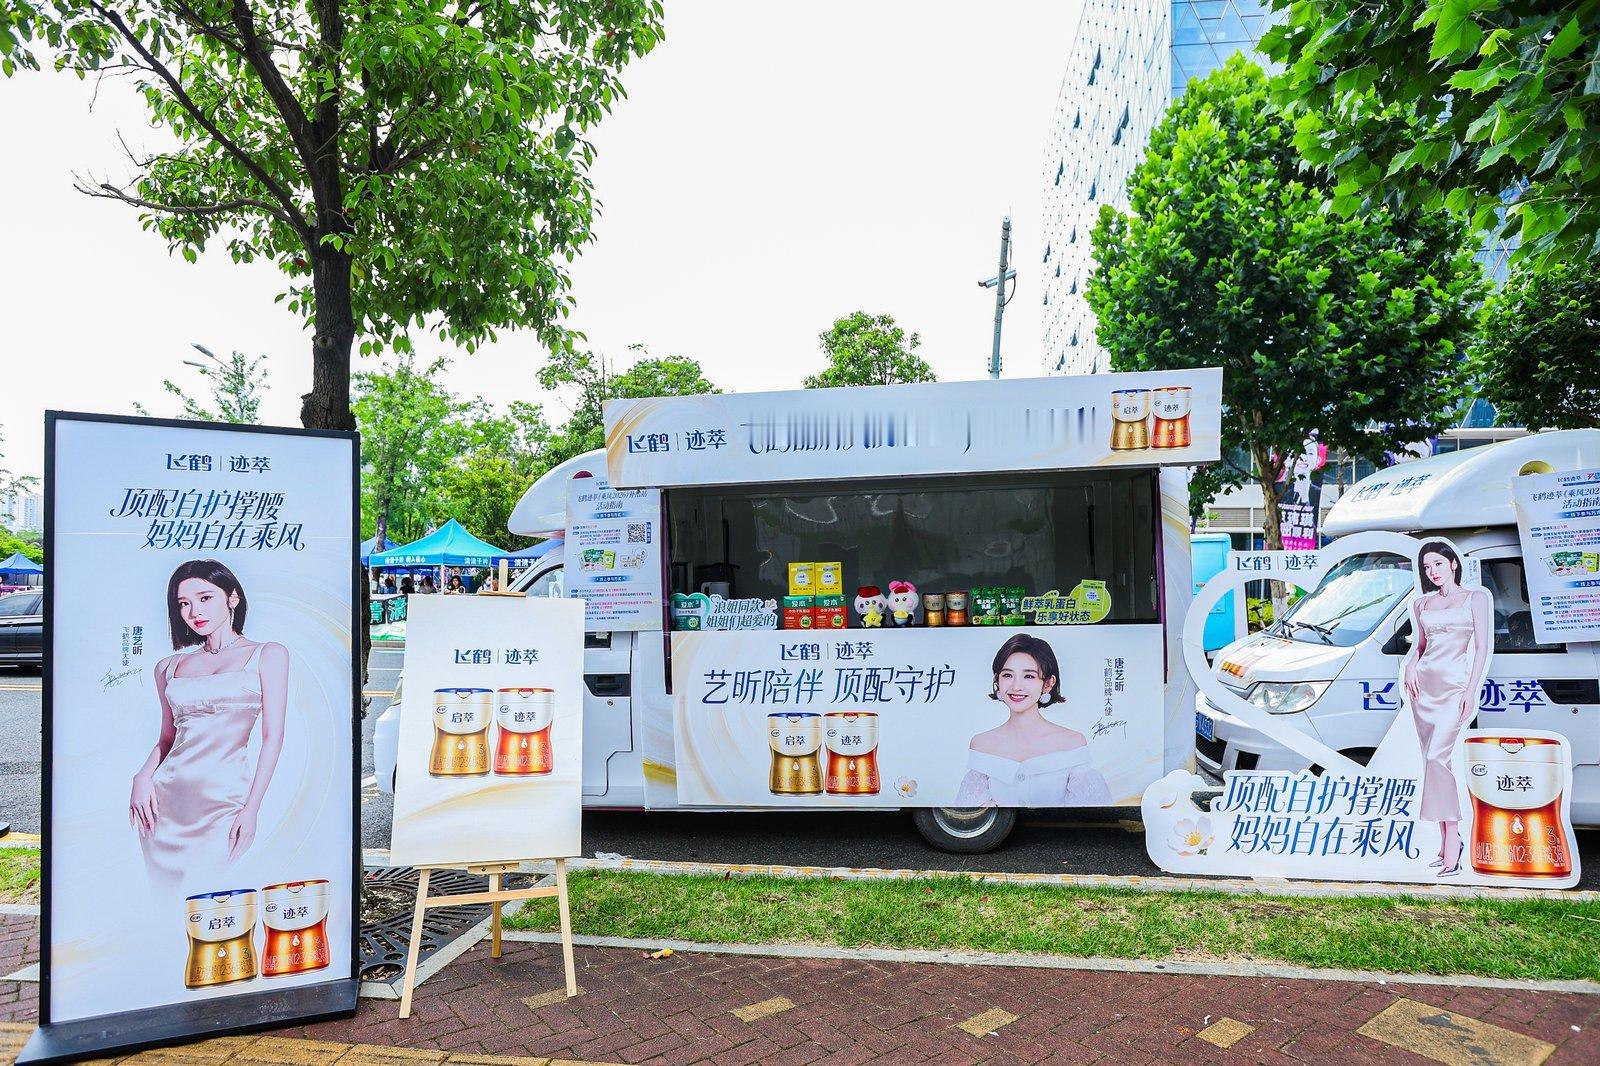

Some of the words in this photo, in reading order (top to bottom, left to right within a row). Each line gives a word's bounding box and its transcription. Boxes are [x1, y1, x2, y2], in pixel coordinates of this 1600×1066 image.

[626, 432, 669, 454] 飞鹤
[685, 429, 727, 451] 迹萃
[165, 453, 212, 472] 飞鹤
[229, 455, 271, 474] 迹萃
[109, 487, 286, 521] 顶配自护撑腰
[141, 519, 305, 552] 妈妈自在乘风
[1236, 556, 1271, 571] 飞鹤
[1285, 554, 1318, 571] 迹萃
[713, 599, 762, 614] 浪姐同款
[1023, 598, 1076, 609] 鲜萃乳蛋白
[706, 613, 776, 630] 姐姐们超爱的
[1037, 610, 1091, 622] 乐享好状态
[132, 625, 143, 656] 唐艺昕
[454, 649, 491, 665] 飞鹤
[505, 649, 539, 665] 迹萃
[780, 643, 820, 661] 飞鹤
[835, 641, 874, 661] 迹萃
[1114, 657, 1124, 692] 唐艺昕
[701, 668, 824, 705] 艺昕陪伴
[831, 664, 957, 705] 顶配守护
[1104, 658, 1113, 717] 飞鹤品牌大使
[451, 712, 475, 723] 启萃
[514, 711, 537, 723] 迹萃
[785, 735, 806, 746] 启萃
[841, 735, 863, 746] 迹萃
[1496, 775, 1534, 793] 迹萃
[1215, 775, 1418, 817] 顶配自护撑腰
[1229, 816, 1421, 860] 妈妈自在乘风
[283, 906, 309, 921] 迹萃
[208, 916, 236, 931] 启萃
